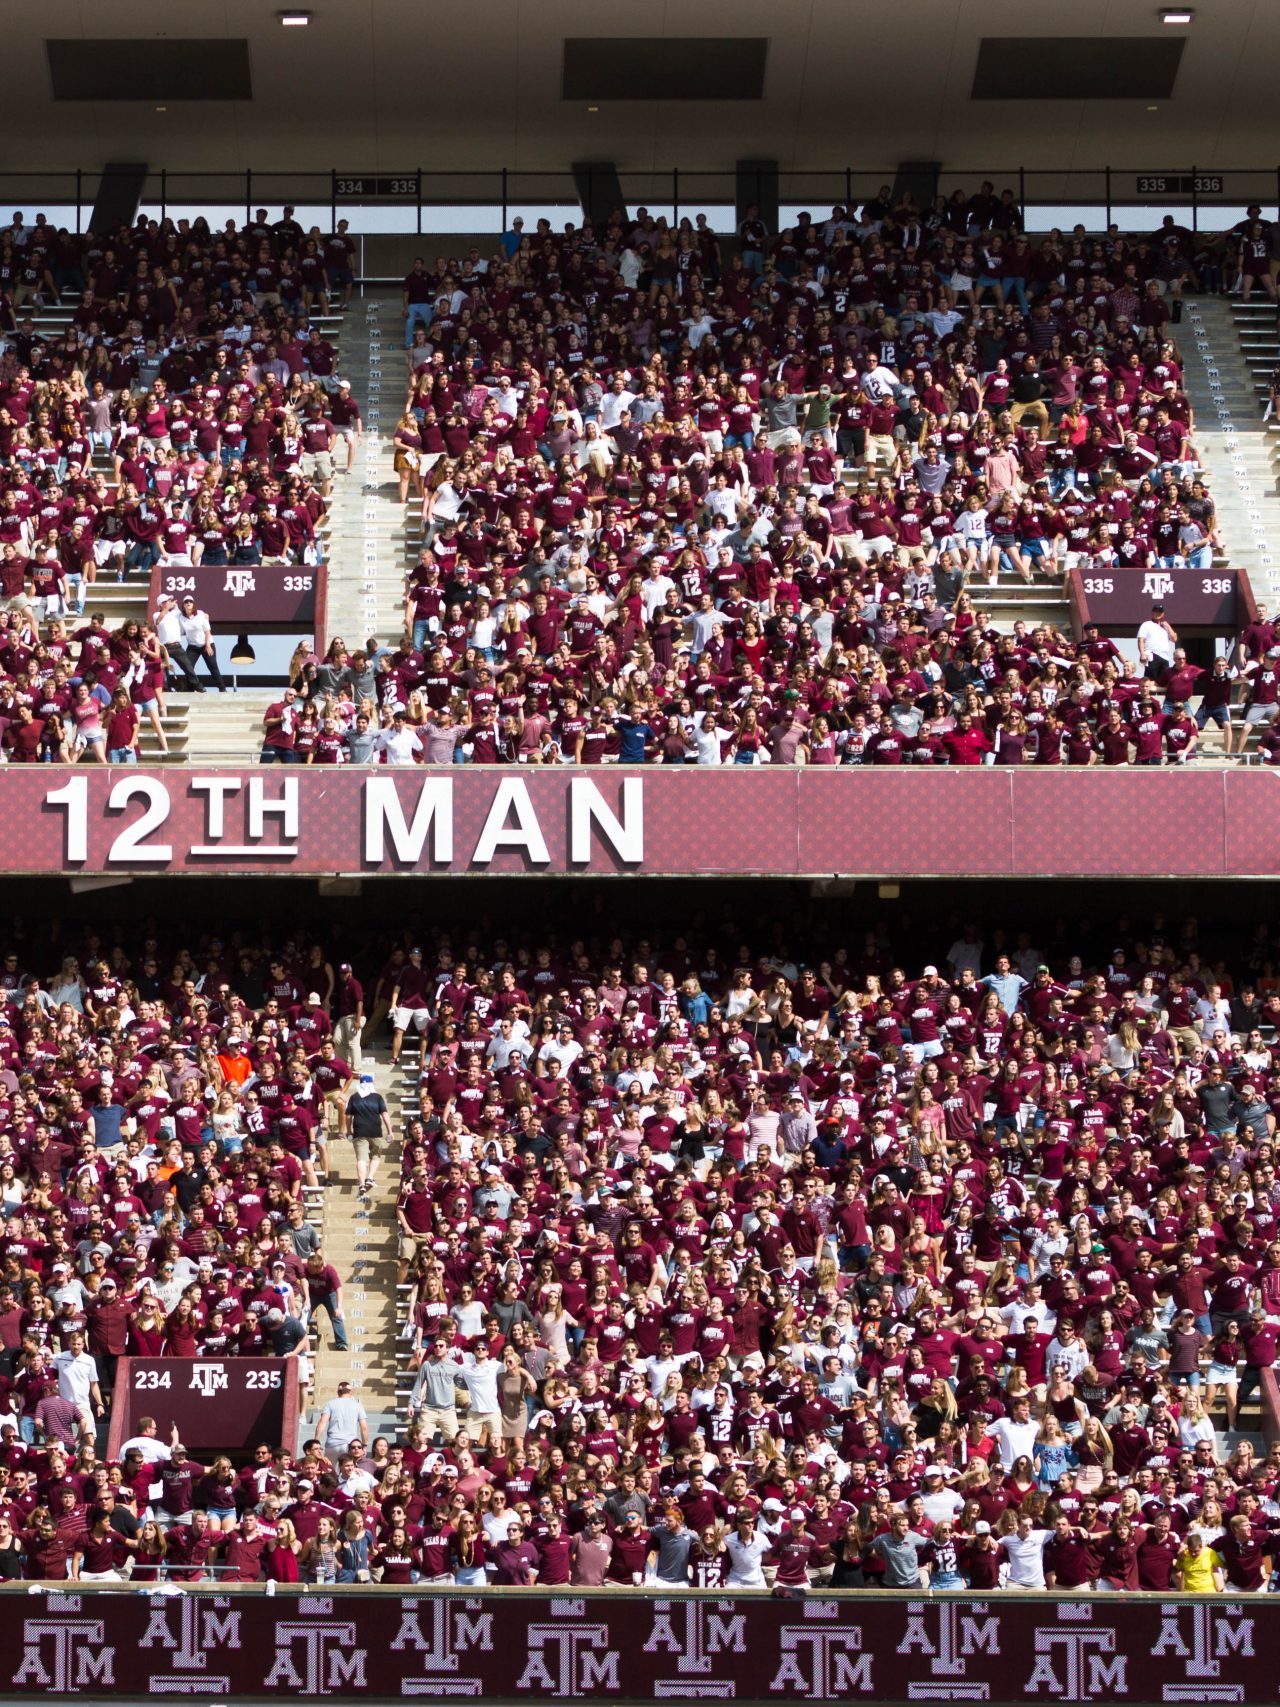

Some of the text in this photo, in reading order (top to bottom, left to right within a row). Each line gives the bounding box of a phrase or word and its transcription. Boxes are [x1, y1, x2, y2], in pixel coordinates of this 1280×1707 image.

[338, 181, 364, 194] 334
[391, 181, 417, 194] 335
[1140, 179, 1166, 192] 335
[1194, 179, 1221, 192] 336
[1253, 245, 1266, 257] 12
[678, 256, 689, 269] 12
[1, 268, 10, 278] 12
[880, 347, 895, 363] 12
[865, 382, 881, 399] 12
[284, 440, 298, 455] 12
[970, 519, 982, 530] 12
[166, 577, 197, 591] 334
[283, 577, 313, 591] 335
[682, 578, 702, 596] 12
[913, 583, 929, 600] 12
[1084, 579, 1114, 593] 335
[1202, 579, 1232, 593] 336
[980, 666, 996, 679] 12
[384, 686, 398, 702] 12
[46, 774, 299, 861] 12TH
[366, 776, 644, 862] MAN
[474, 1002, 490, 1018] 12
[985, 1038, 1000, 1053] 12
[247, 1116, 265, 1133] 12
[1008, 1161, 1021, 1174] 12
[956, 1237, 971, 1254] 12
[135, 1371, 172, 1389] 234
[246, 1371, 281, 1389] 235
[712, 1420, 731, 1441] 12
[936, 1552, 956, 1572] 12
[697, 1568, 720, 1588] 12
